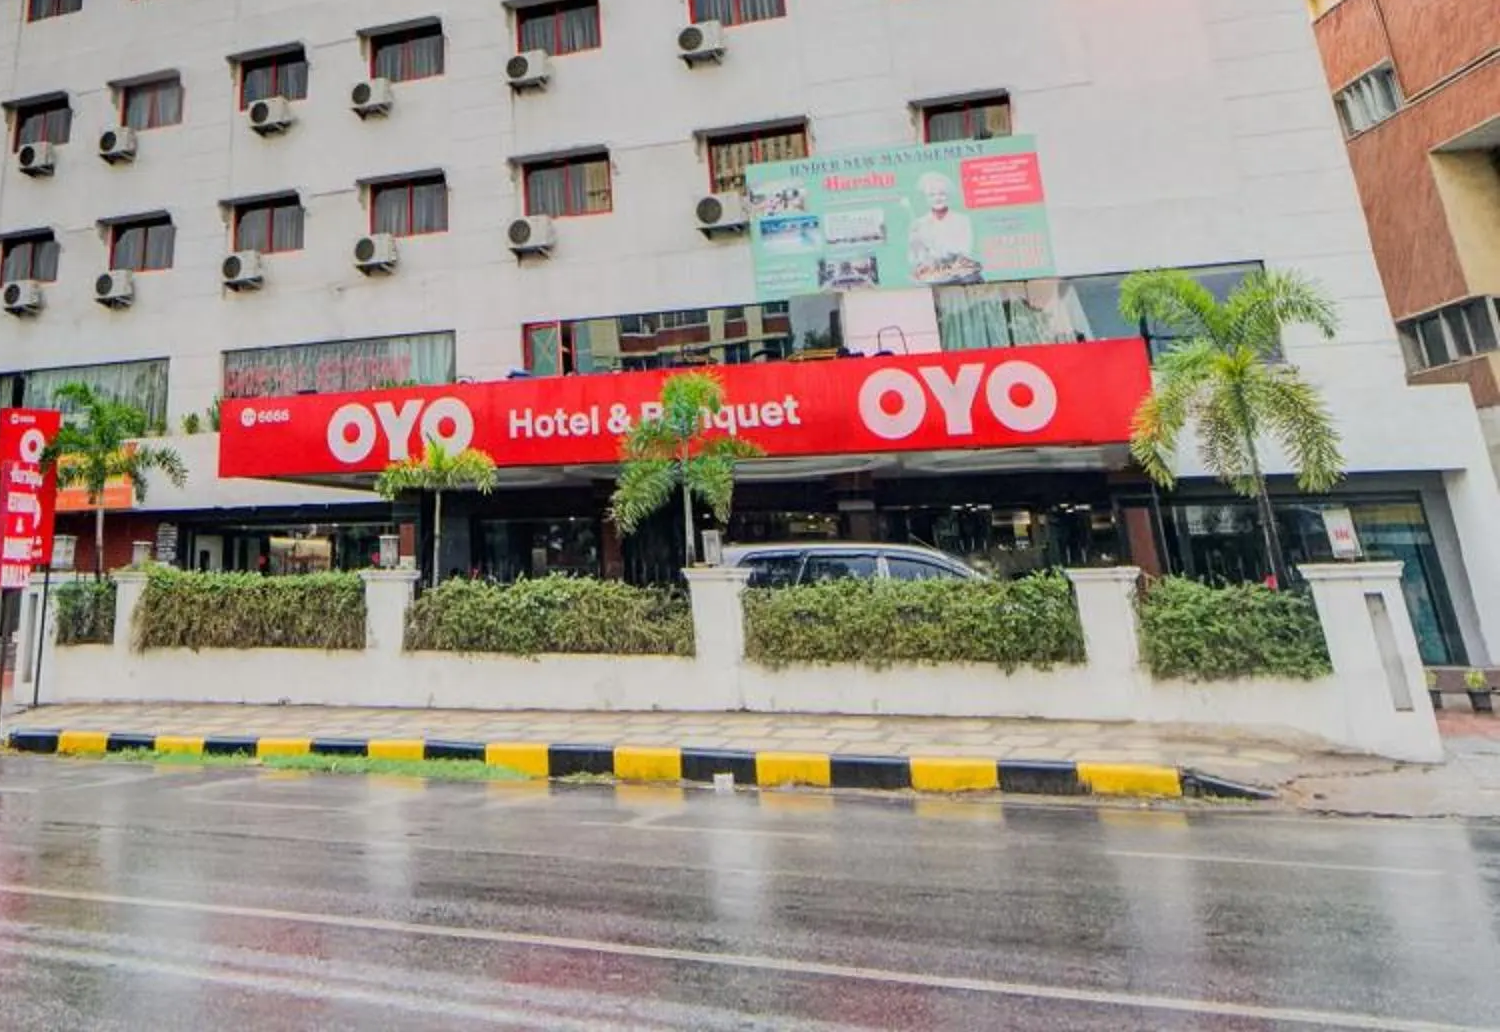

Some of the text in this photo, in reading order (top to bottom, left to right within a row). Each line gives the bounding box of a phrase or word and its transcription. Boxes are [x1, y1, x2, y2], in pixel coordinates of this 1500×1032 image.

[883, 143, 985, 166] MANAGEMENT
[508, 394, 801, 439] Hotel & Bnquet
[857, 360, 1058, 440] OYO
[327, 396, 475, 464] OYO
